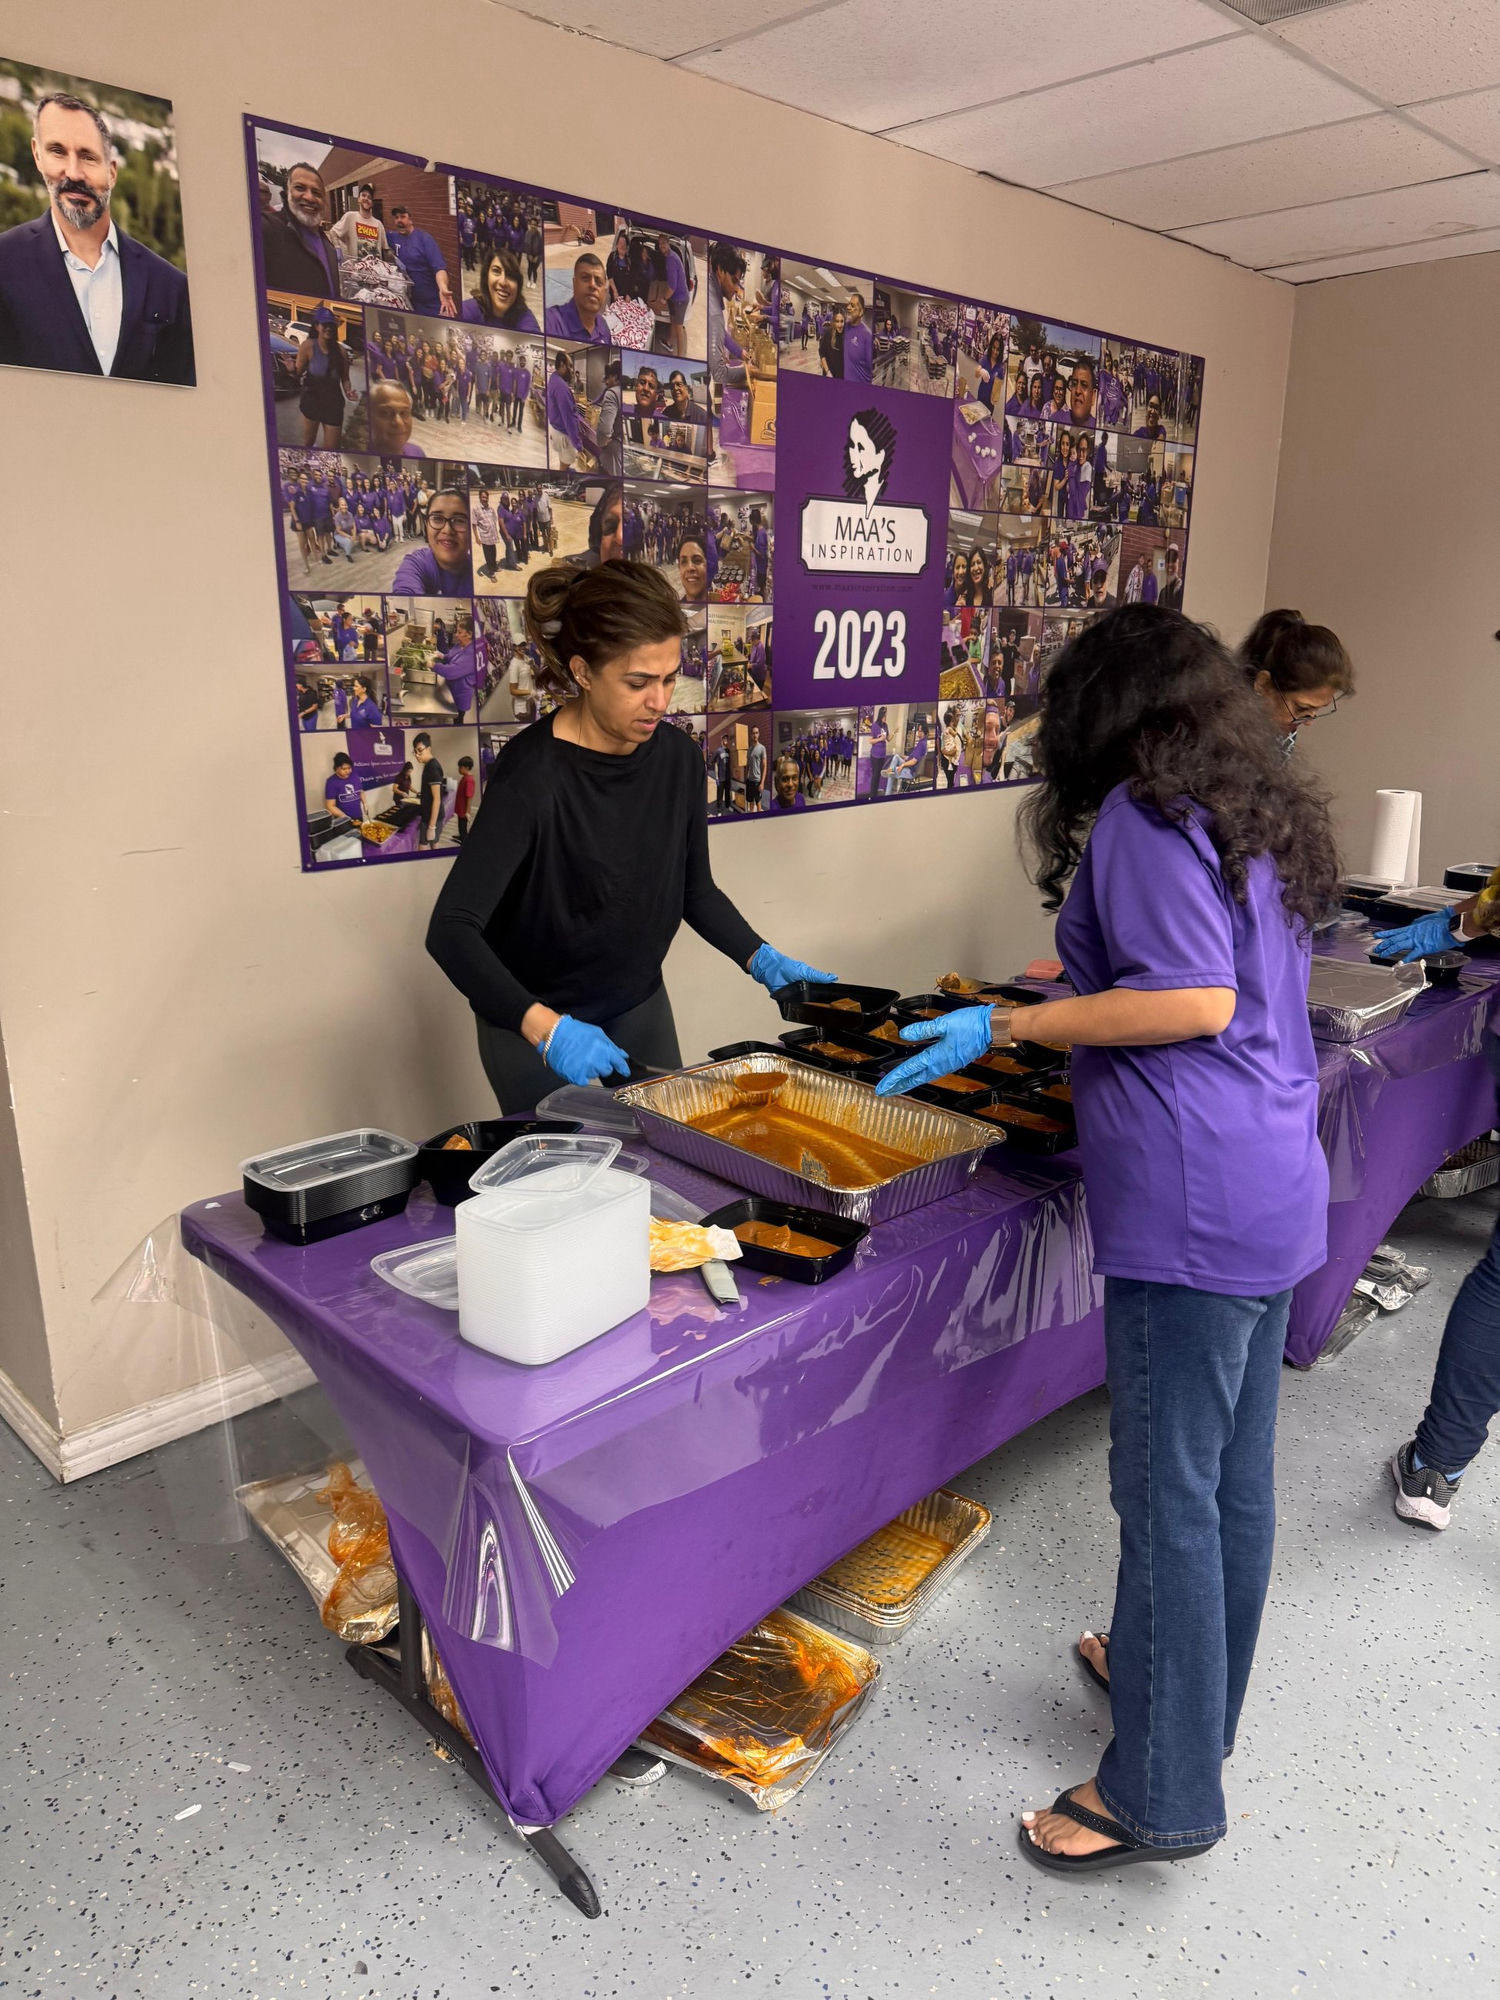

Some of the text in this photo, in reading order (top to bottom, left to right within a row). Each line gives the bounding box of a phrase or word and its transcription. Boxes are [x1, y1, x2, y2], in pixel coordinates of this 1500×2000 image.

[835, 516, 896, 543] MAA'S
[811, 544, 913, 562] INSPIRATION
[813, 609, 906, 680] 2023
